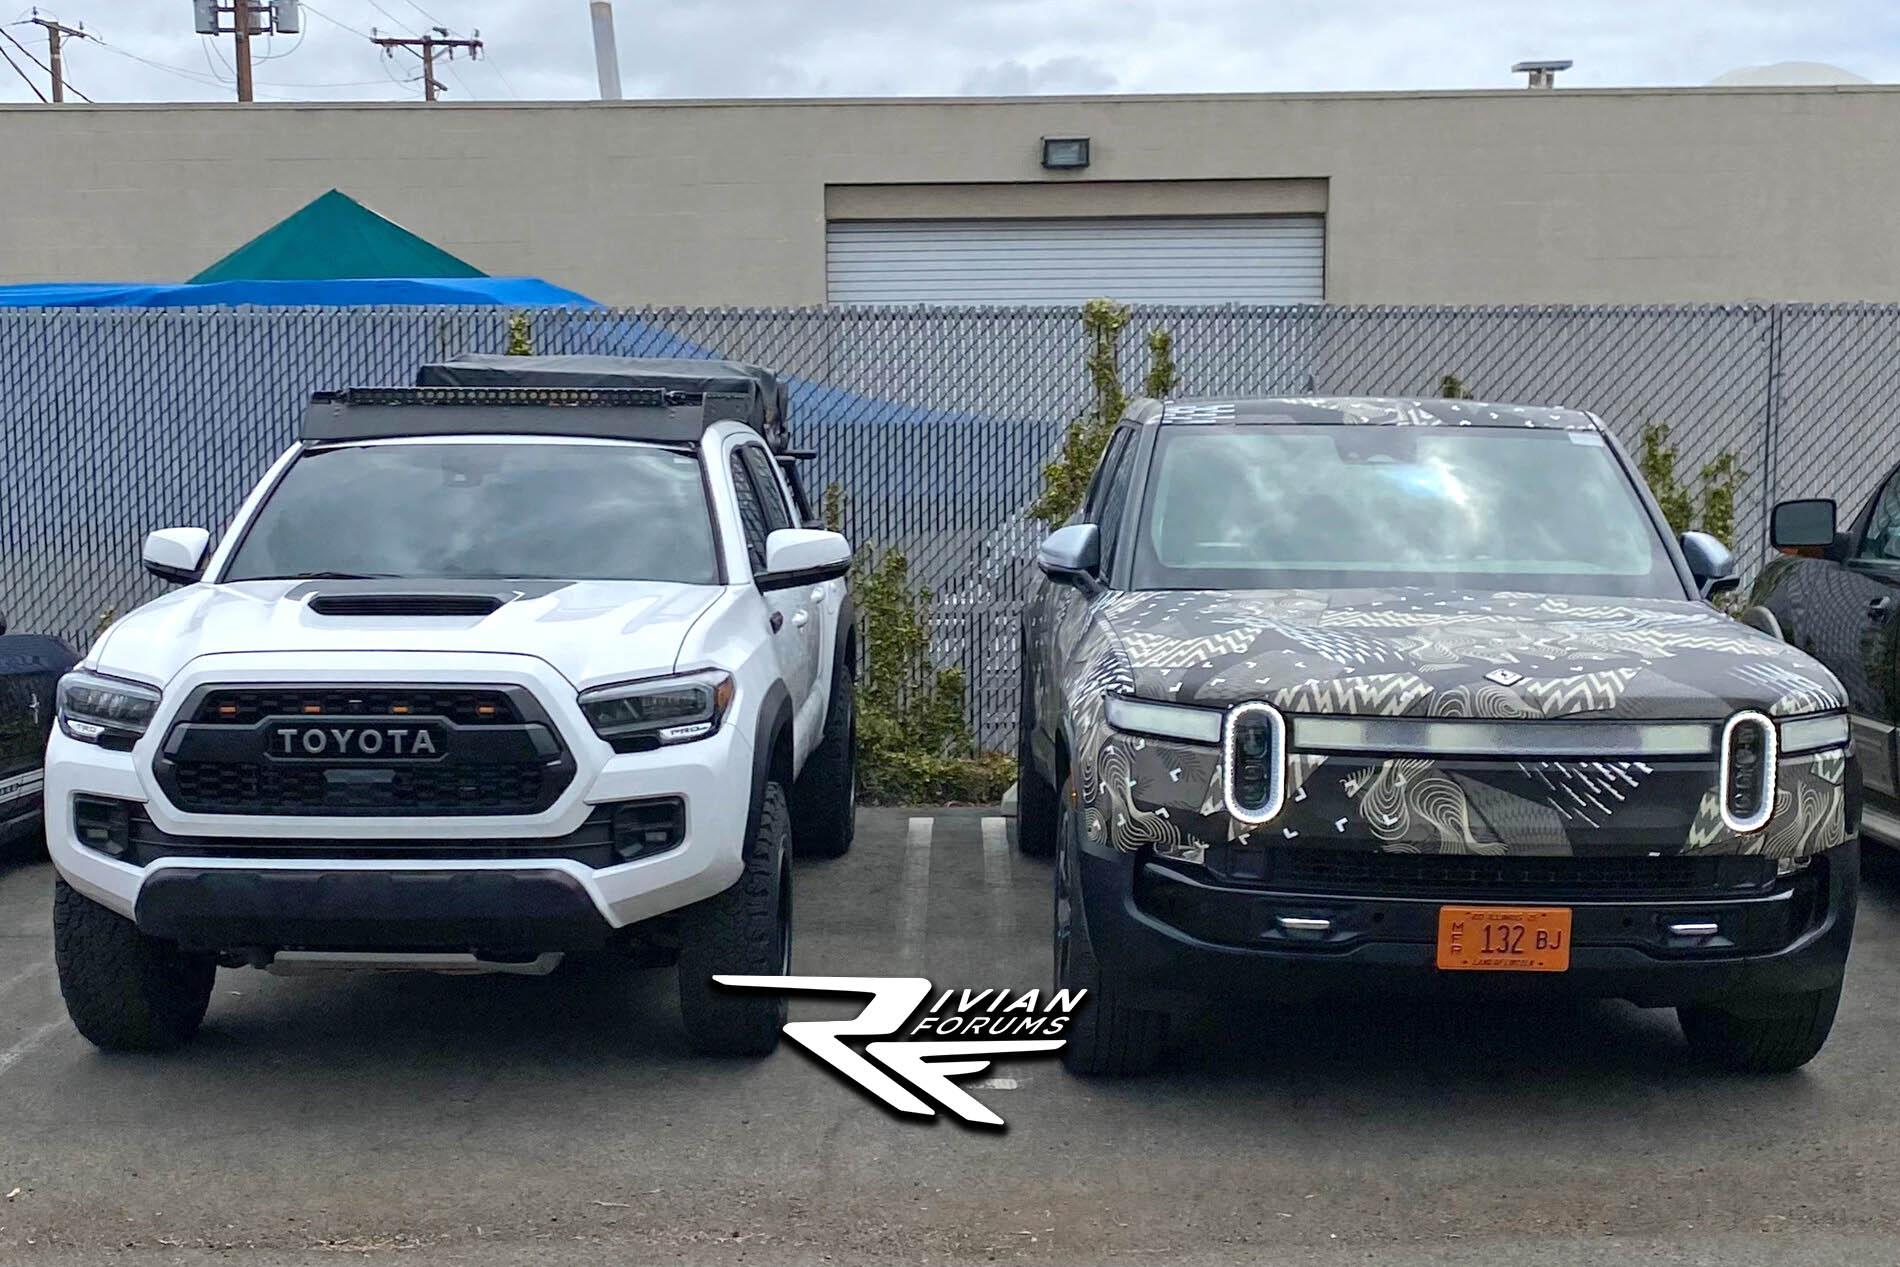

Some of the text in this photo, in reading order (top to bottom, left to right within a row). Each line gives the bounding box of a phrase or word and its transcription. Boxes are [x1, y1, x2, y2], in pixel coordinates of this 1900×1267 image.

[277, 728, 436, 753] TOYOTA
[1481, 924, 1561, 954] 132 BJ
